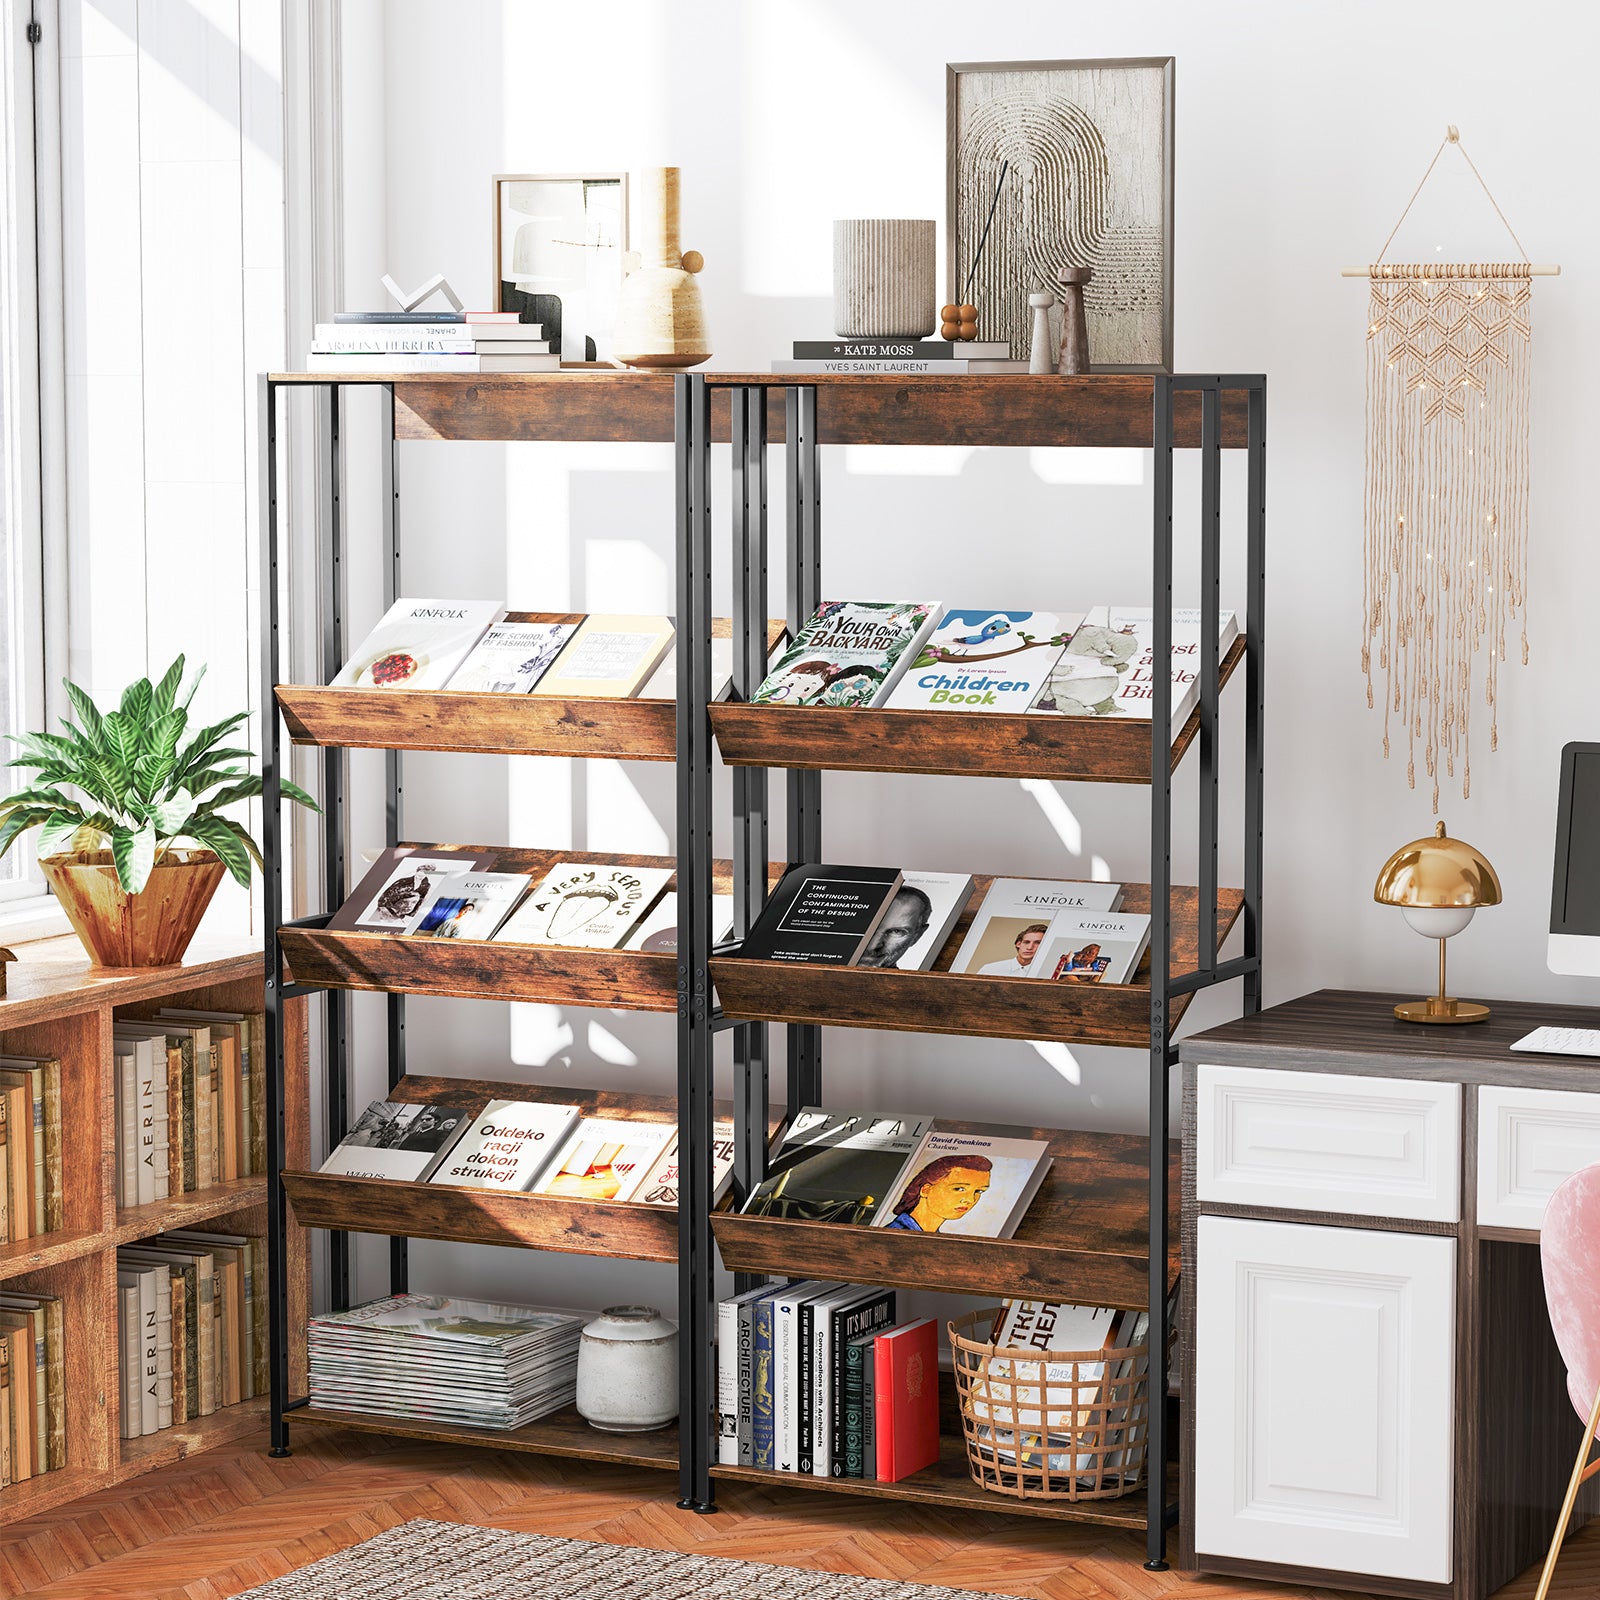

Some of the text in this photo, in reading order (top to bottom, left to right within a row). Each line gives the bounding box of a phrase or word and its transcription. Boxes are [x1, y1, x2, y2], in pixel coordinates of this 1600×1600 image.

[385, 341, 444, 350] HERRERA
[844, 345, 914, 356] KATE MOSS
[825, 363, 928, 372] YVES SAINT LAURENT
[410, 608, 468, 620] KINFOLK
[822, 616, 903, 637] IN YOUR OWN
[508, 632, 544, 640] SCHOOL
[808, 630, 894, 650] BACKYARD
[496, 640, 538, 648] FASHION
[918, 674, 1030, 692] Children
[929, 690, 997, 705] Book
[536, 872, 643, 916] A VERY SERIOUS
[807, 892, 860, 900] CONTINUOUS
[1024, 895, 1085, 906] KINFOLK
[802, 900, 870, 910] CONTAMINATION
[1079, 922, 1126, 931] KINFOLK
[142, 1079, 154, 1167] AERIN
[796, 1112, 924, 1138] CEREAL
[480, 1125, 545, 1140] Oddeko
[483, 1141, 524, 1154] racji
[927, 1143, 959, 1151] Charlotte
[930, 1136, 992, 1147] David Foenkinos
[466, 1152, 519, 1166] dokon
[450, 1166, 518, 1182] strukcji
[846, 1314, 859, 1336] IT'S
[860, 1308, 872, 1330] NOT
[874, 1302, 888, 1324] HOW
[147, 1310, 157, 1397] AERIN
[740, 1319, 750, 1424] ARCHITECTURE
[782, 1463, 790, 1471] K
